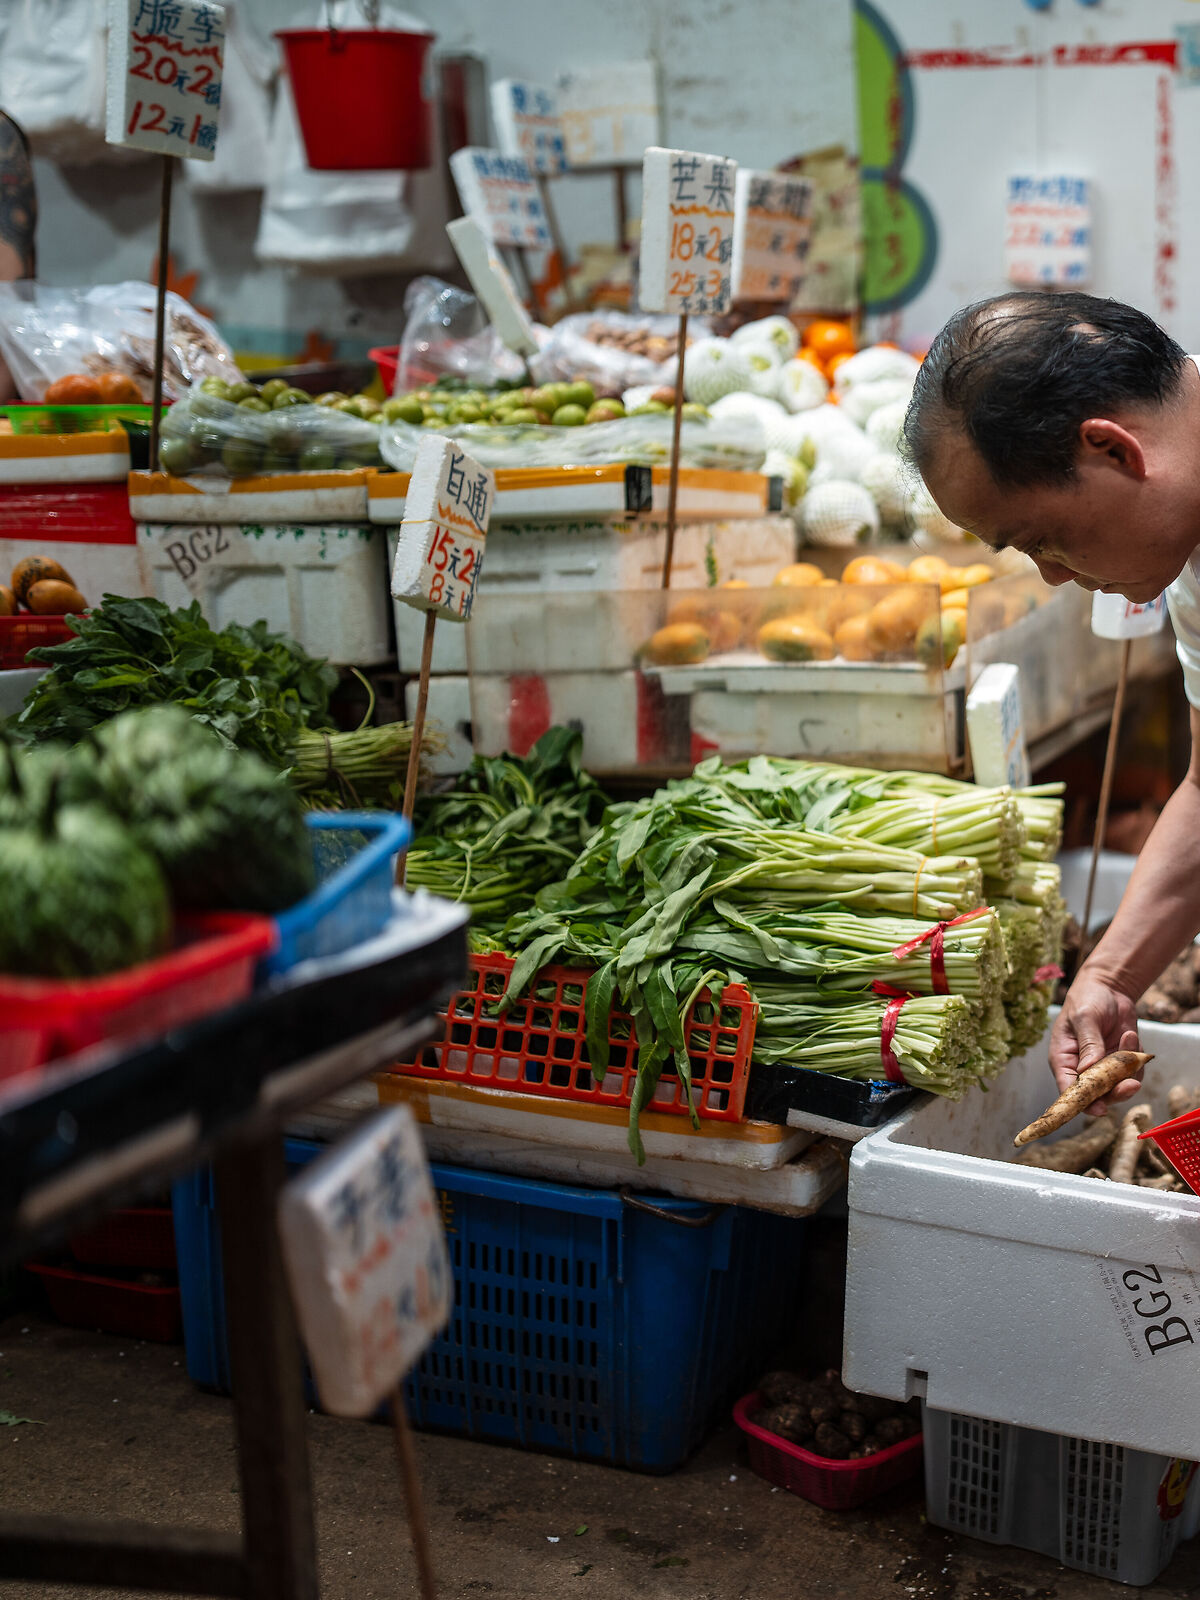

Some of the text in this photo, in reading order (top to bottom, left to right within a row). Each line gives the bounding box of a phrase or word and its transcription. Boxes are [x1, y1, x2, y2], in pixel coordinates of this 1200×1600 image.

[672, 157, 732, 212] 芒果
[165, 524, 229, 581] BG2
[1122, 1264, 1194, 1355] BG2
